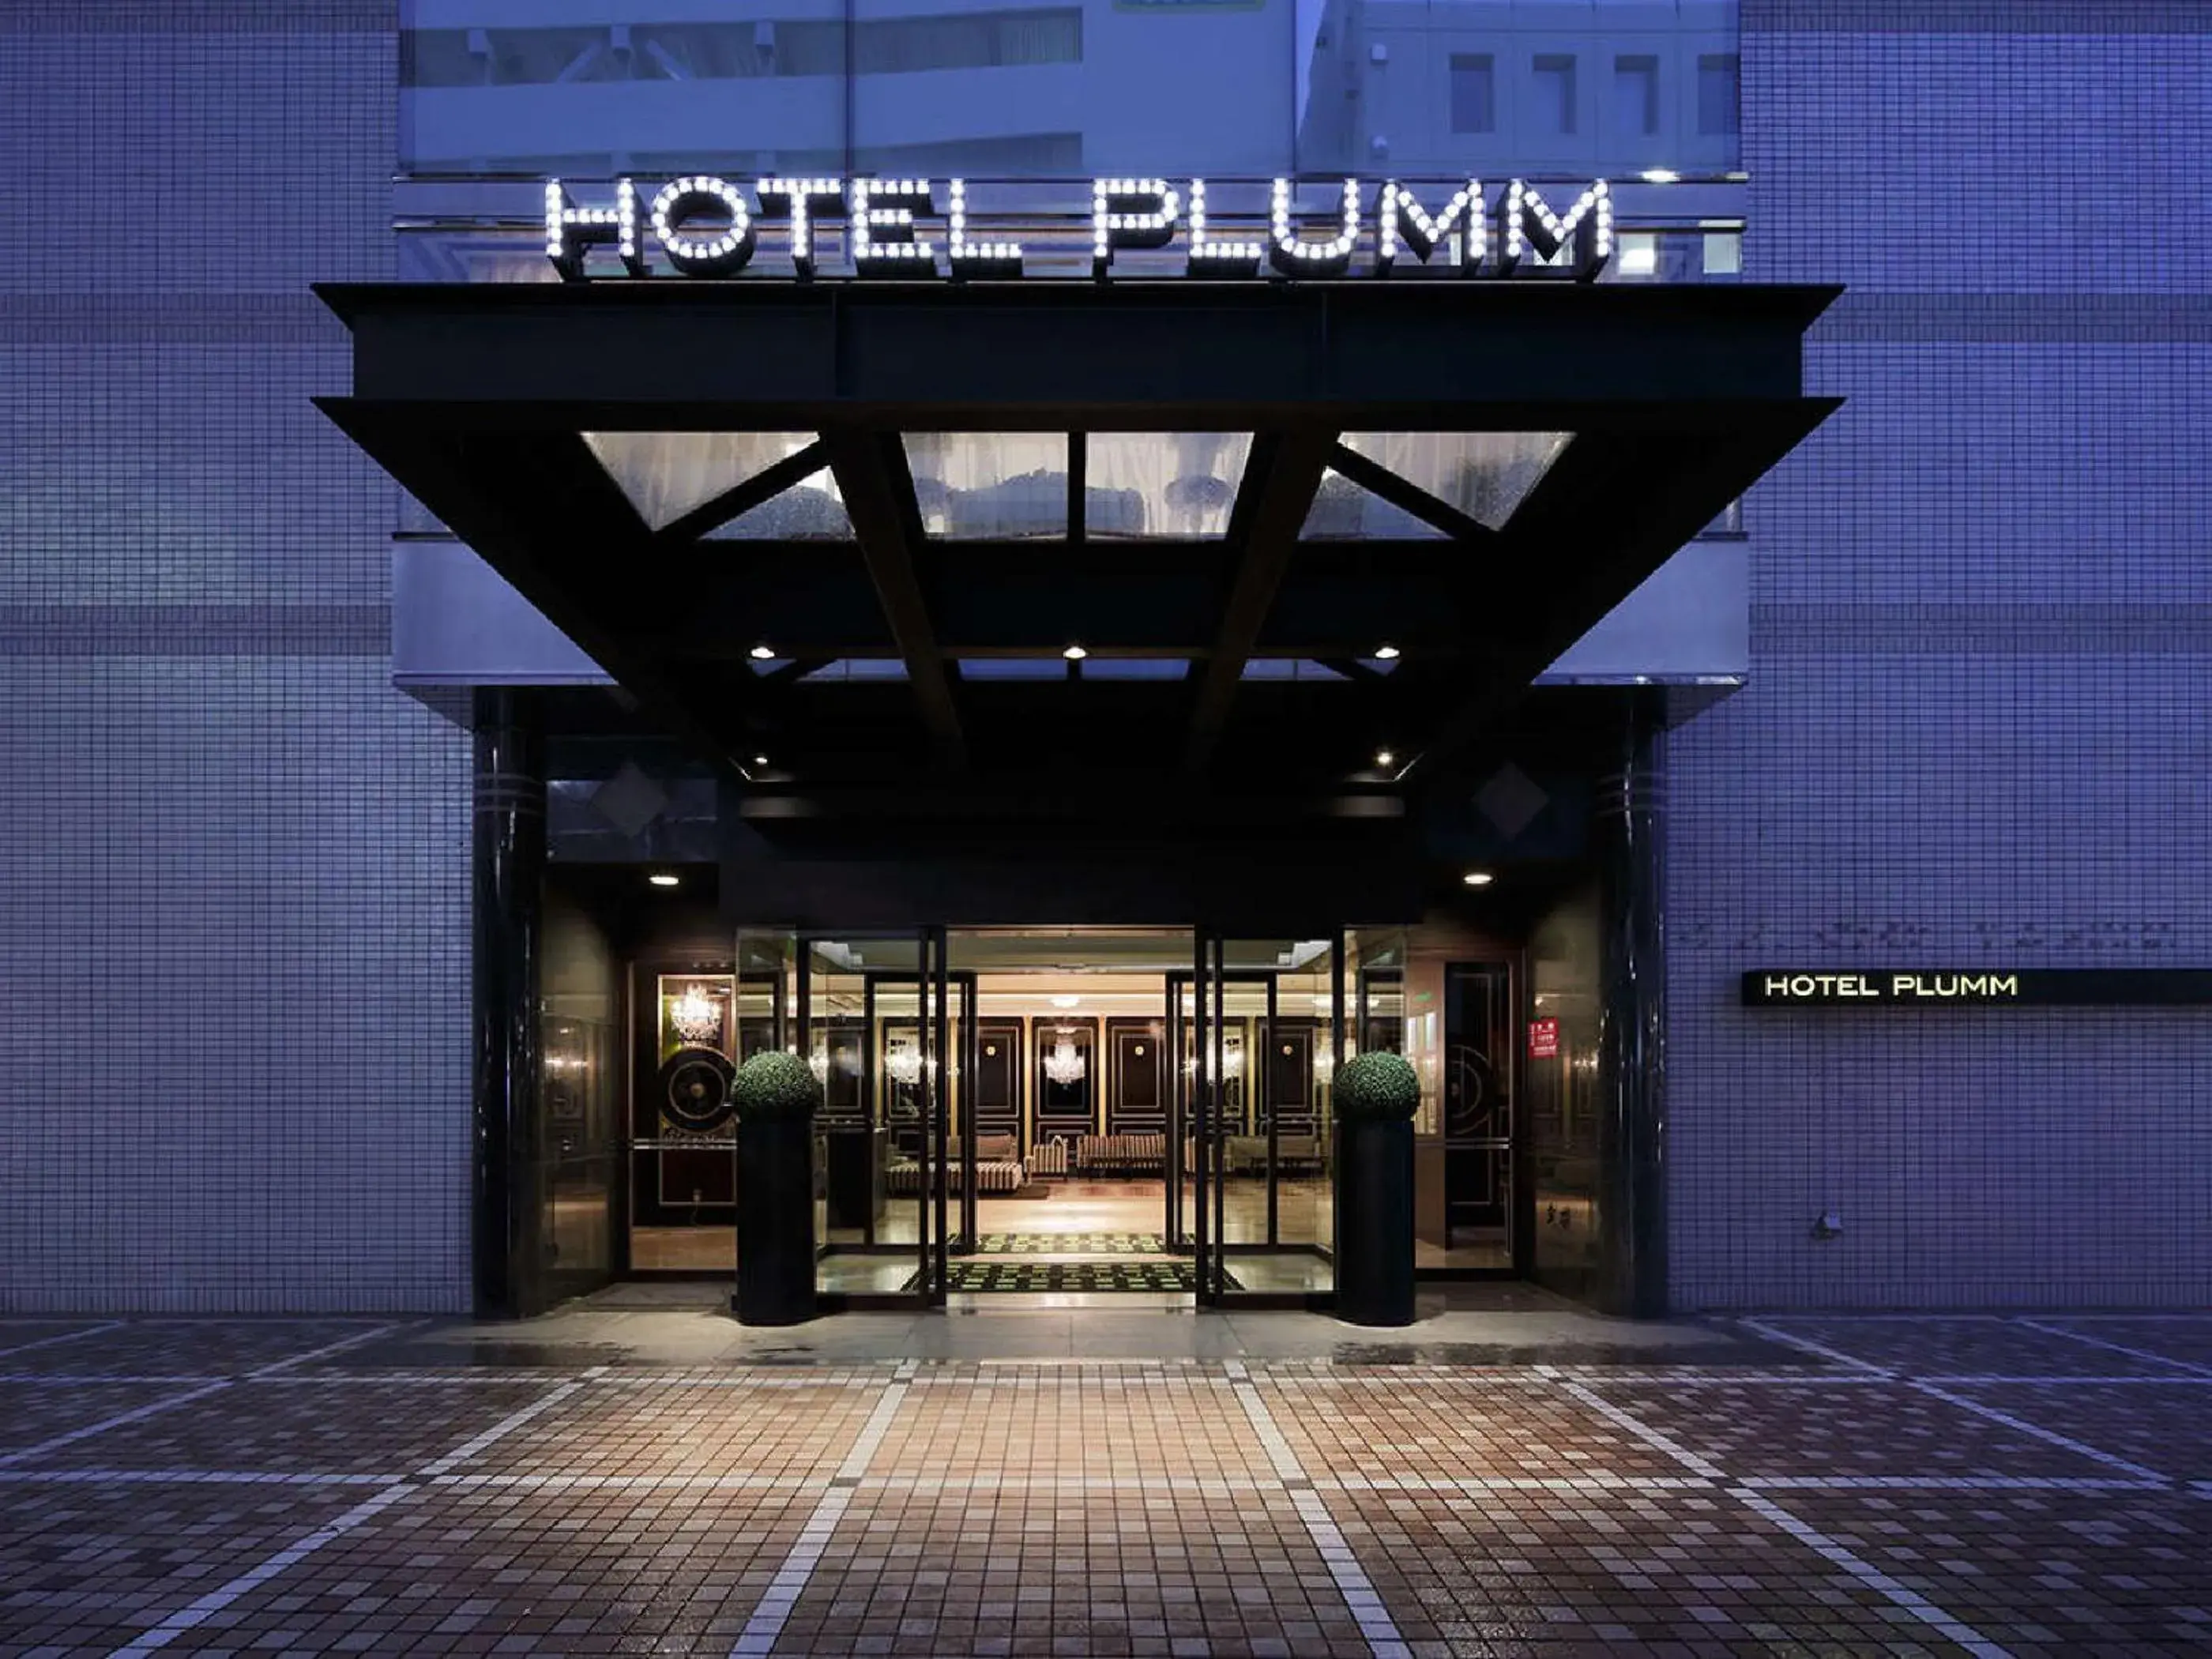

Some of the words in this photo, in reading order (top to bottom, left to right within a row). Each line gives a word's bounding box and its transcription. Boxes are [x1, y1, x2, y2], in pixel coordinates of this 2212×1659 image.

[544, 176, 1023, 258] HOTEL
[1093, 179, 1612, 258] PLUMM
[1765, 974, 1879, 996] HOTEL
[1892, 974, 2018, 996] PLUMM
